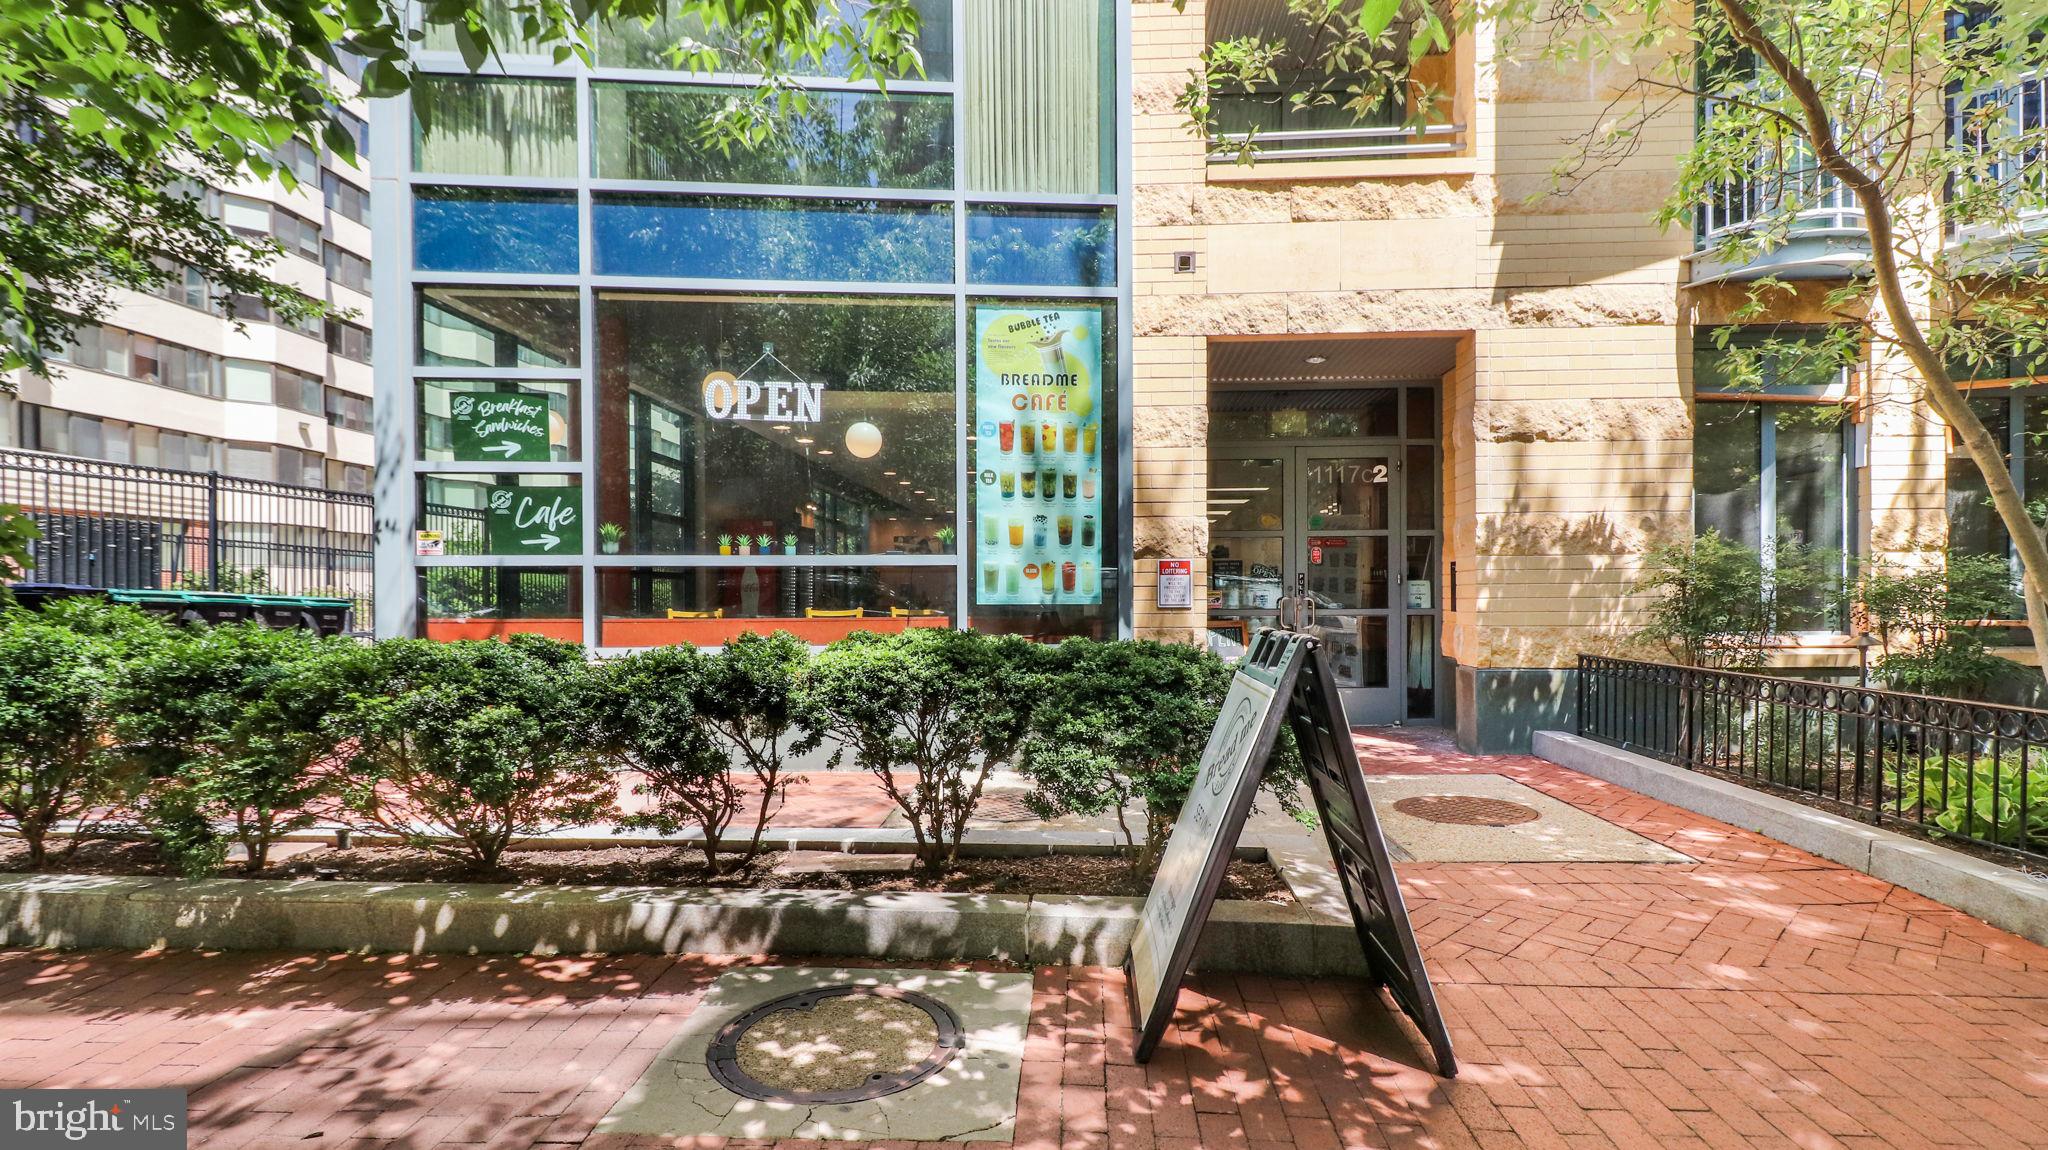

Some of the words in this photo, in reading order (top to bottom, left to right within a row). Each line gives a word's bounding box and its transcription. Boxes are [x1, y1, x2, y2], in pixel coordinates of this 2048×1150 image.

[1008, 317, 1041, 334] BUBBLE
[1043, 311, 1061, 324] TEA
[1001, 373, 1078, 387] BREADME
[477, 398, 543, 418] Breakfast
[704, 379, 825, 423] OPEN
[471, 417, 545, 438] Sandwiches
[514, 496, 576, 532] Cafe
[1203, 732, 1239, 789] Bread
[1239, 711, 1258, 743] me
